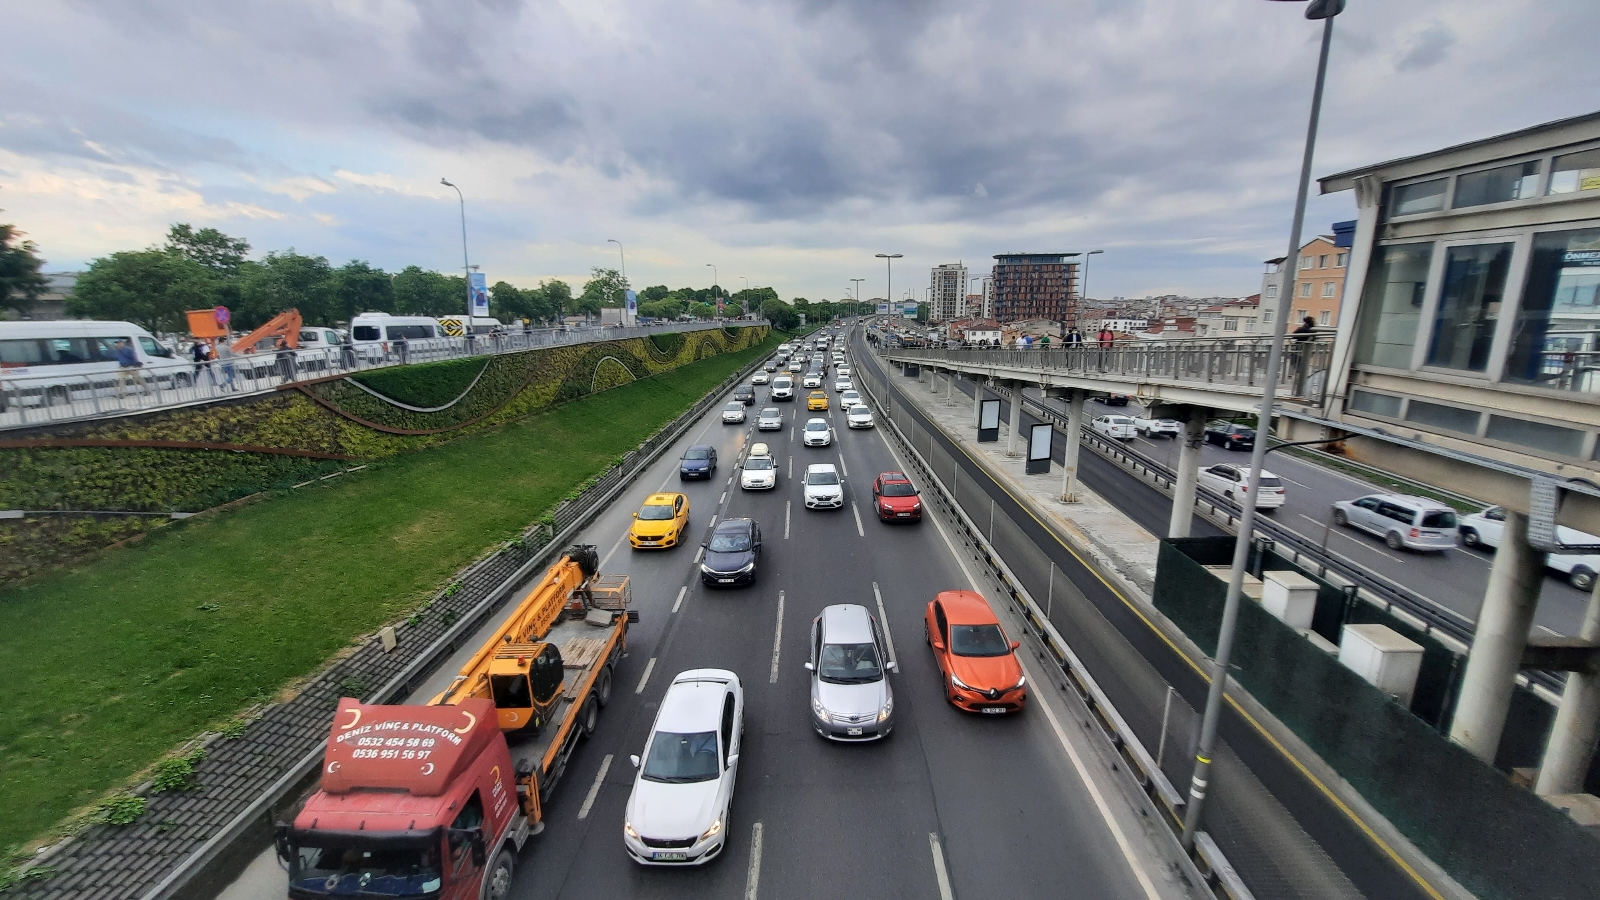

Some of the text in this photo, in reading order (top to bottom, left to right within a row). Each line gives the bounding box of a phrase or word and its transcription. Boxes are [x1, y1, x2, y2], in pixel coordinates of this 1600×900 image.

[336, 721, 462, 746] DENİZ VİNÇ & PLATFORM
[358, 737, 435, 747] 0532 454 58 69
[352, 748, 431, 760] 0536 951 56 97
